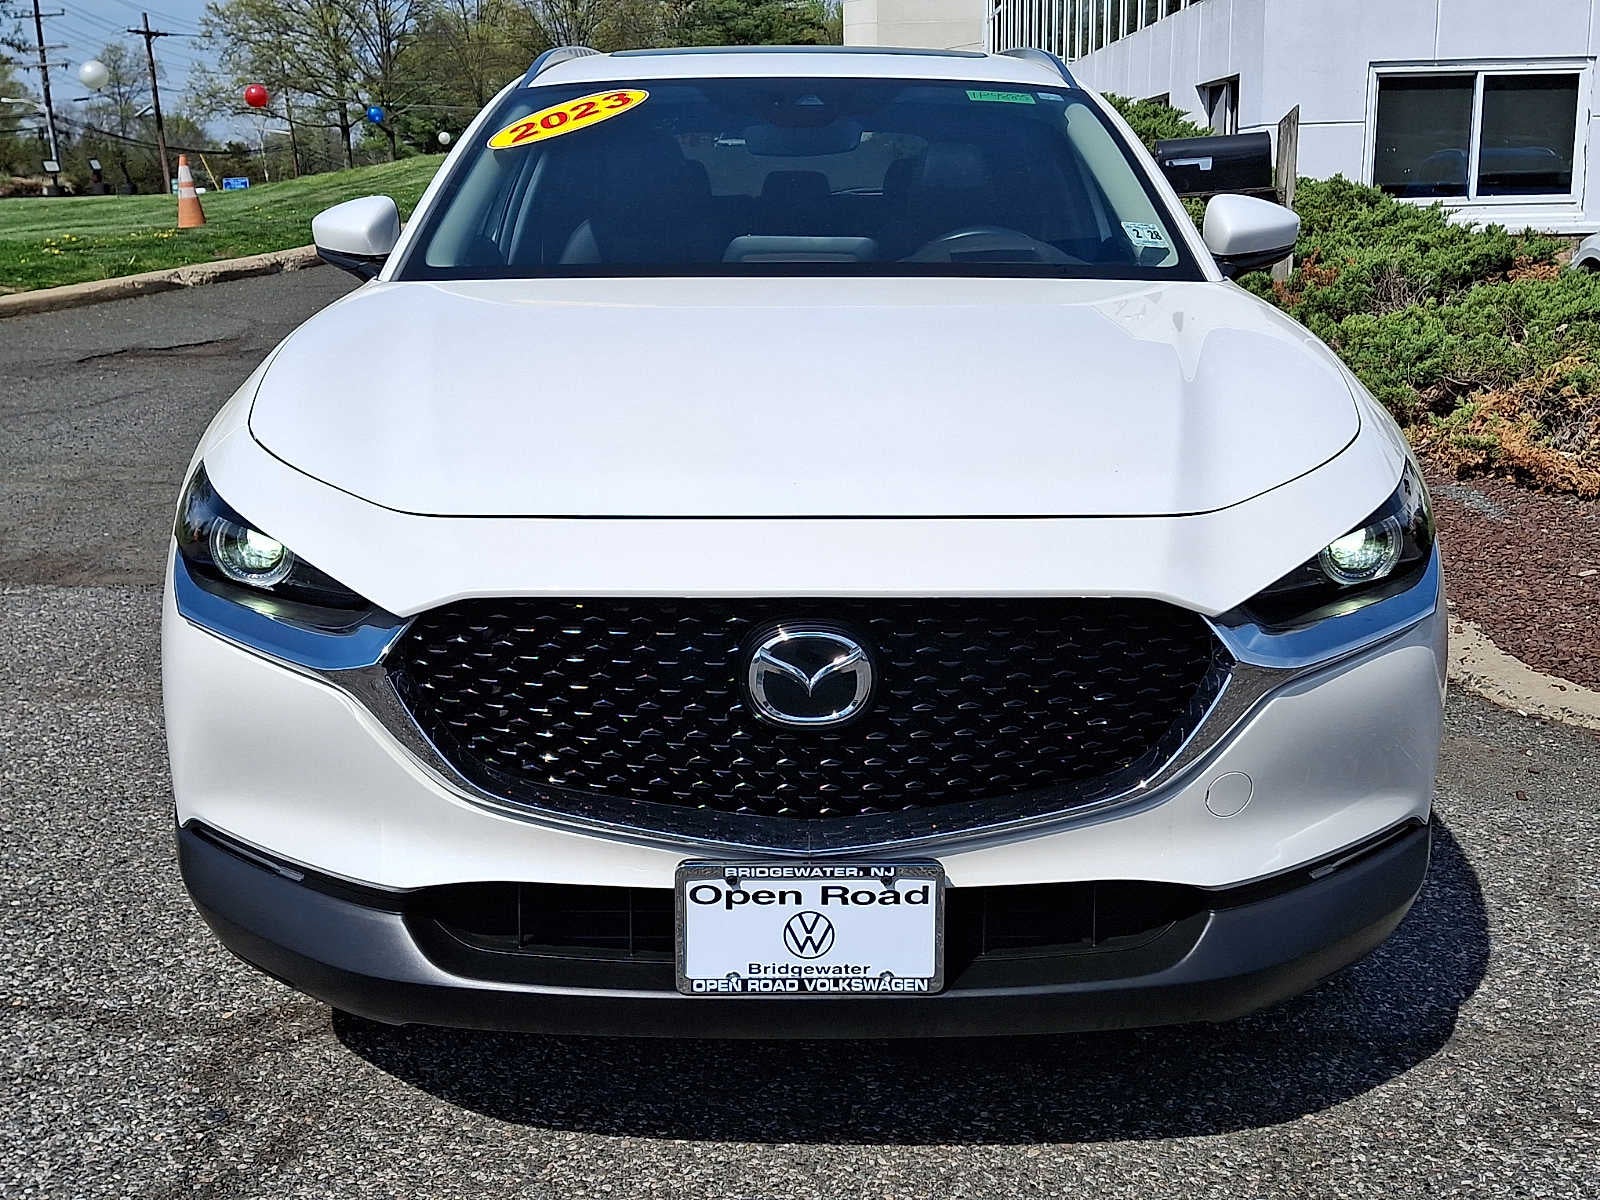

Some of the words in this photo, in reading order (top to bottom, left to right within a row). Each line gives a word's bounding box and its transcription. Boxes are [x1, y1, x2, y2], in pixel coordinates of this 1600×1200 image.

[509, 92, 633, 143] 2023
[1132, 229, 1142, 238] 2
[1147, 230, 1162, 240] 28
[870, 867, 895, 877] NJ
[689, 884, 803, 910] Open
[820, 885, 929, 906] Road
[748, 963, 871, 976] Bridgewater
[692, 980, 743, 992] OPEN
[747, 980, 799, 992] ROAD
[804, 979, 928, 992] VOLKSWAGEN
